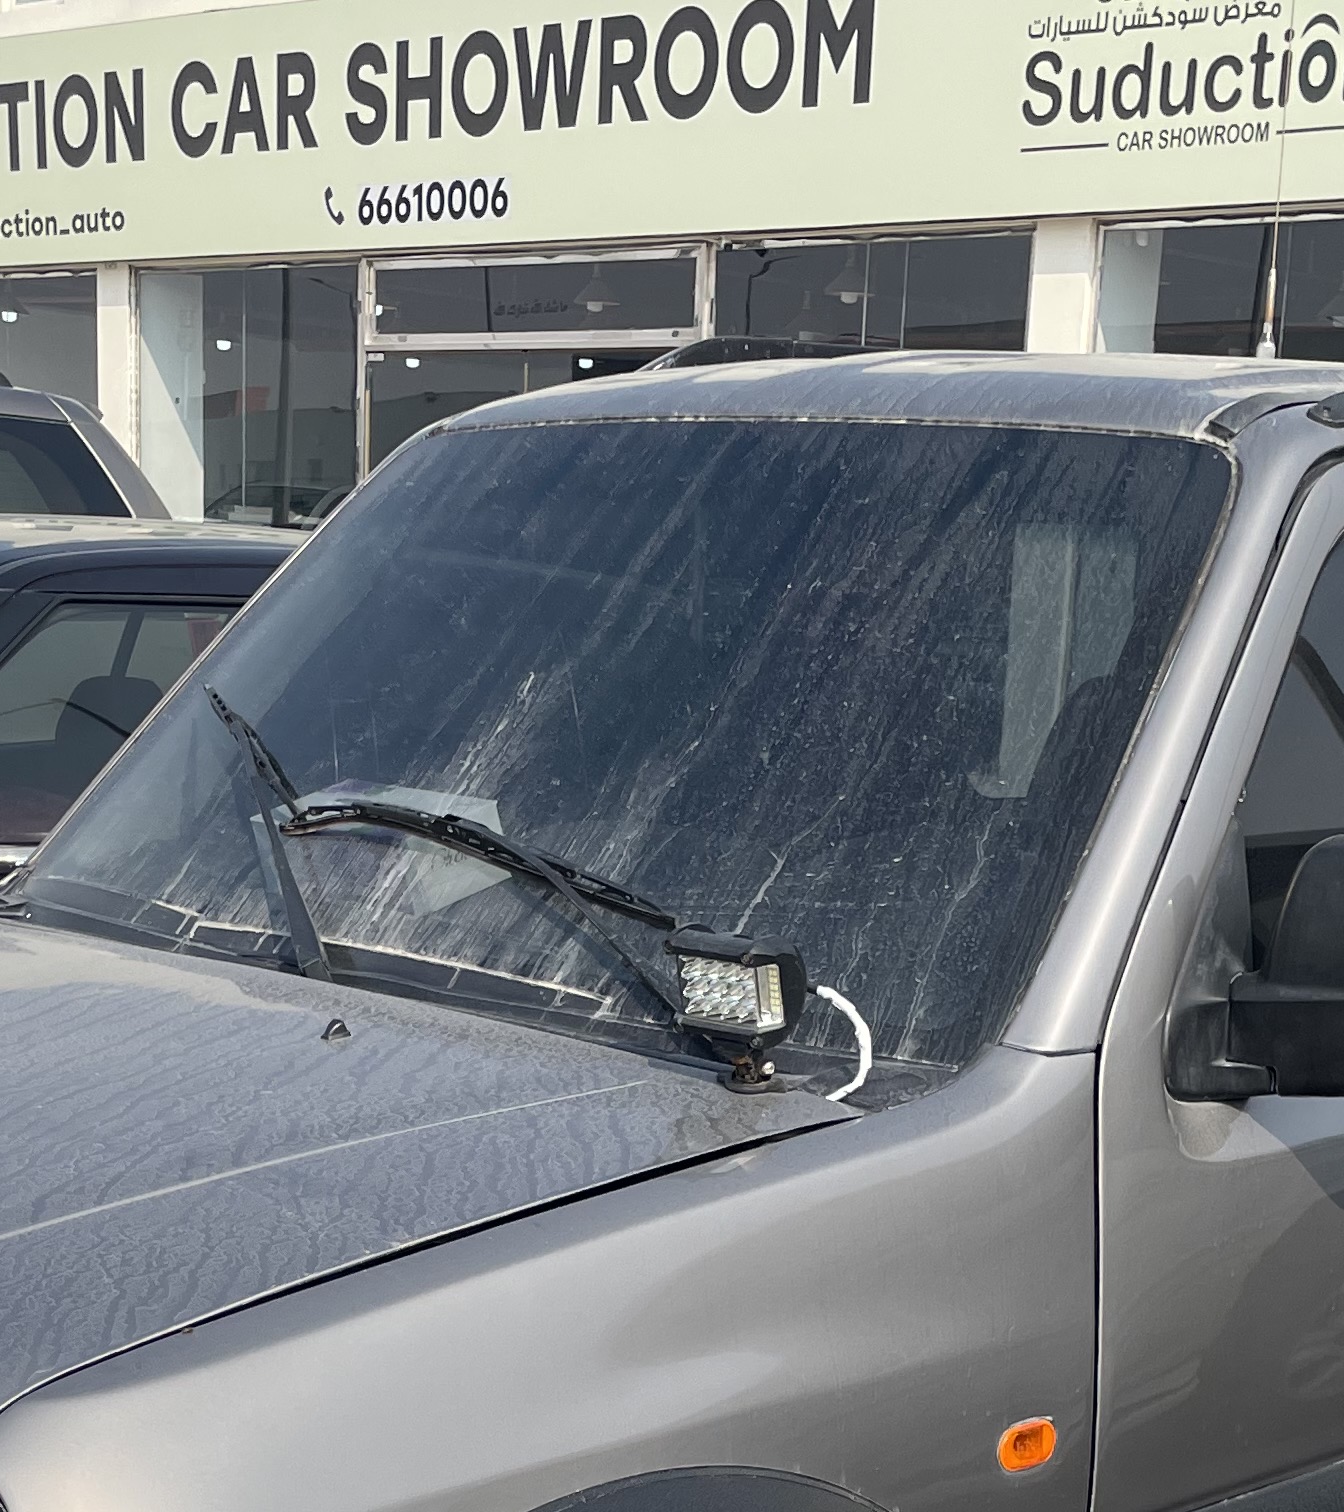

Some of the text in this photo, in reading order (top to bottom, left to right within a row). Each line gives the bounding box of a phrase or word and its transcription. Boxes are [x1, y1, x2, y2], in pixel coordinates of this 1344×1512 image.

[1028, 11, 1109, 42] للسيارات
[171, 51, 318, 158] CAR
[345, 0, 875, 146] SHOWROOM
[1117, 122, 1270, 152] CAR SHOWROOM
[358, 177, 509, 225] 66610006
